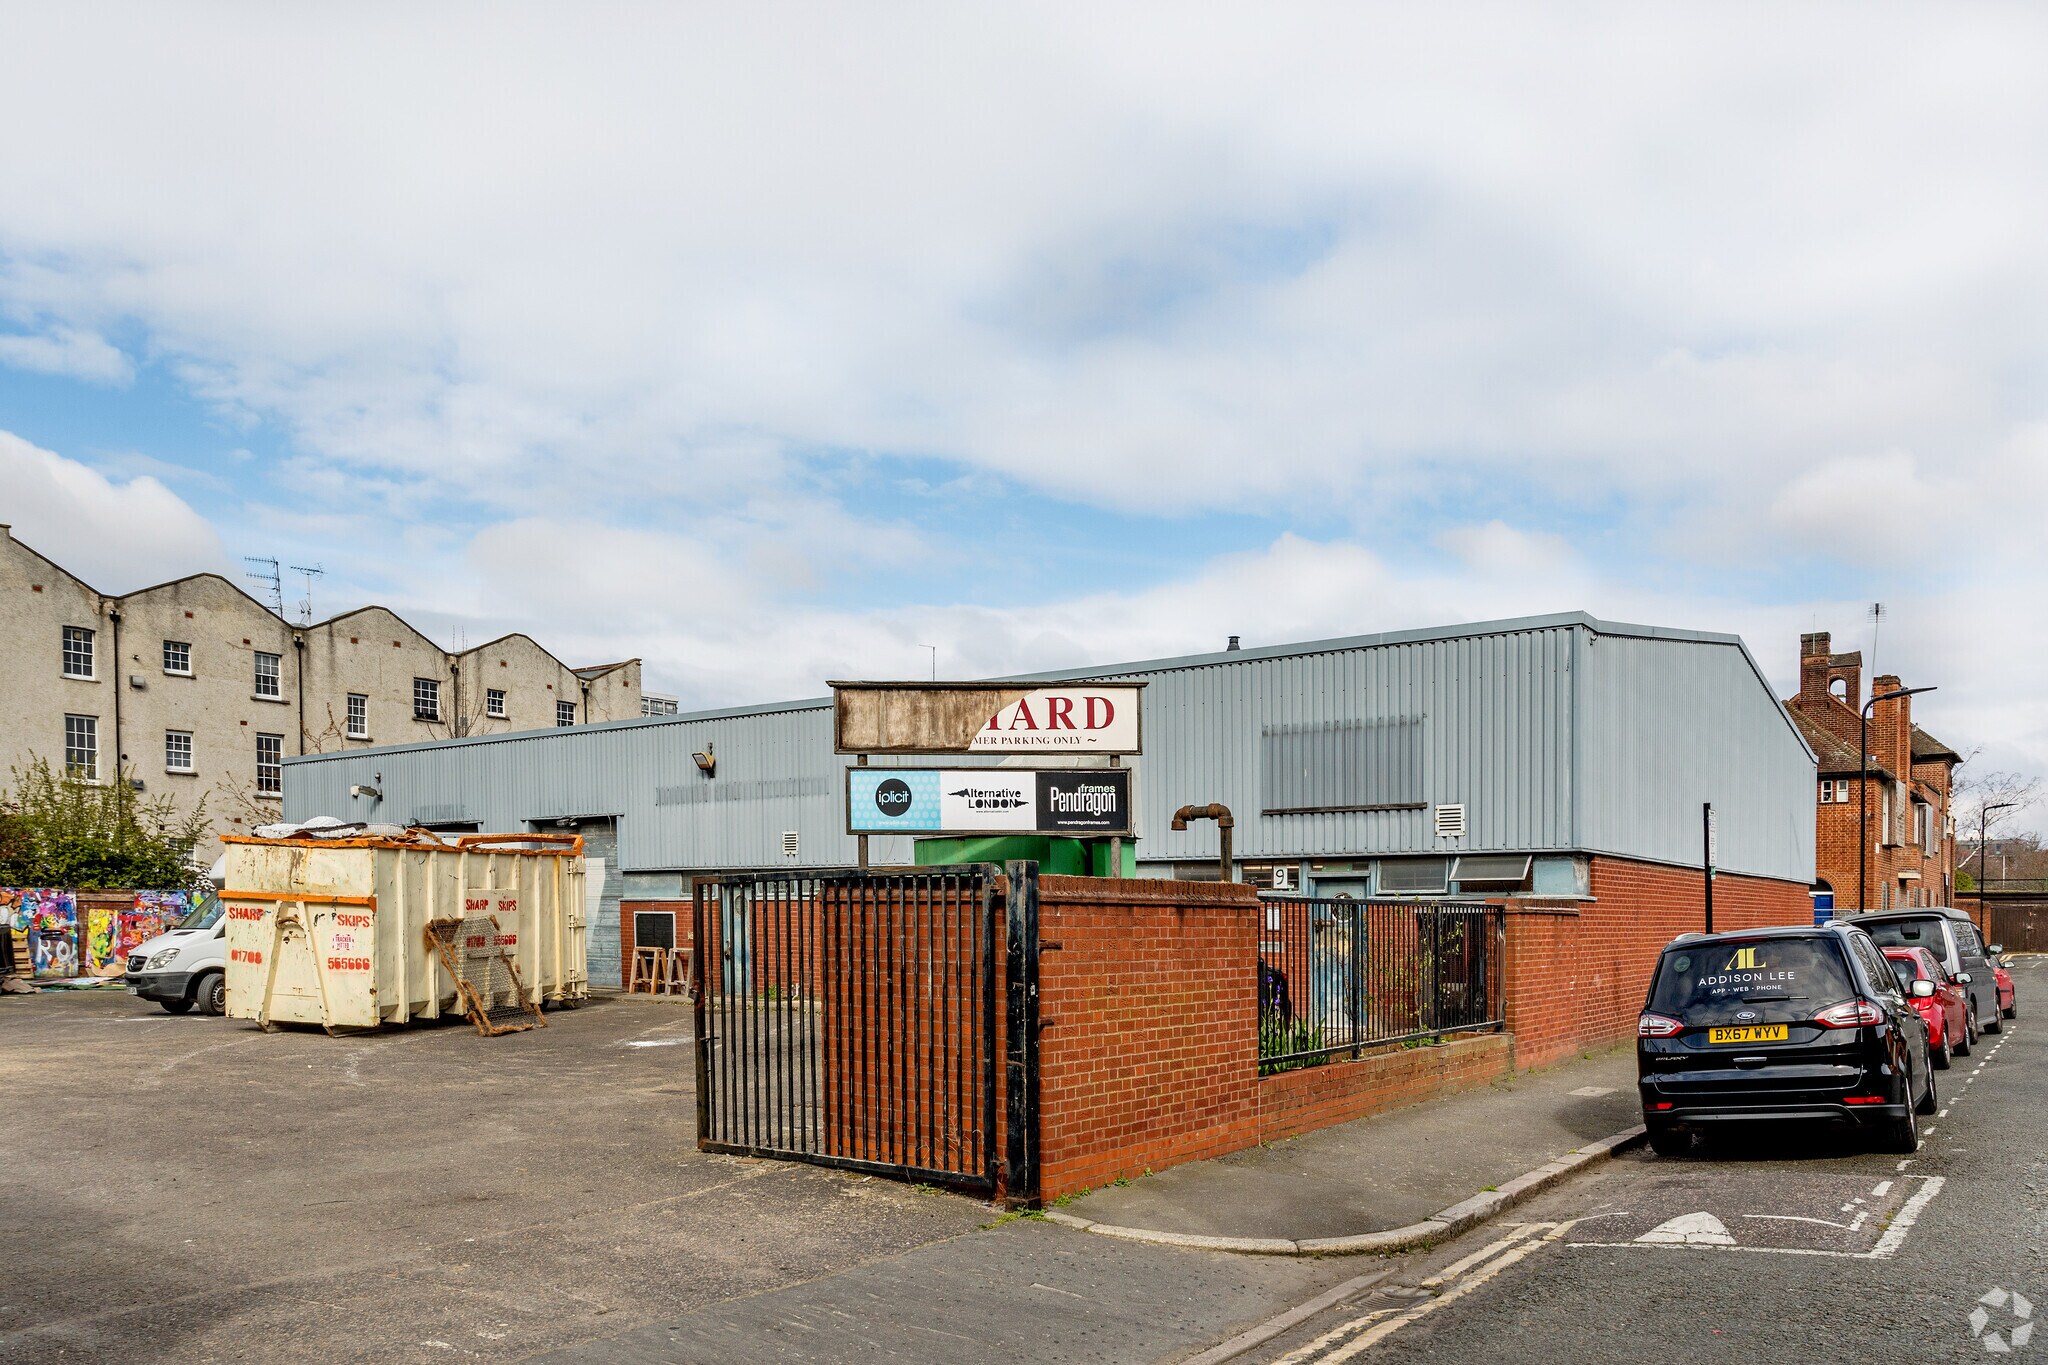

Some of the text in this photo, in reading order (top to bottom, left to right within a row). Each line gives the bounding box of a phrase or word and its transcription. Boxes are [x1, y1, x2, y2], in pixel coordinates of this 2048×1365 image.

[1001, 736, 1050, 745] PARKING
[1053, 736, 1082, 745] ONLY
[966, 788, 1022, 798] Alternative
[1080, 783, 1116, 793] frames
[878, 790, 910, 806] iplicit
[968, 799, 1017, 809] LONDON
[1050, 786, 1117, 816] Pendragon
[1276, 869, 1284, 885] 9
[466, 899, 517, 911] SHARP SKIPS
[228, 907, 371, 928] SHARP SKIPS
[1698, 972, 1796, 986] ADDISON LEE
[1715, 1027, 1780, 1041] BX67 WYV
